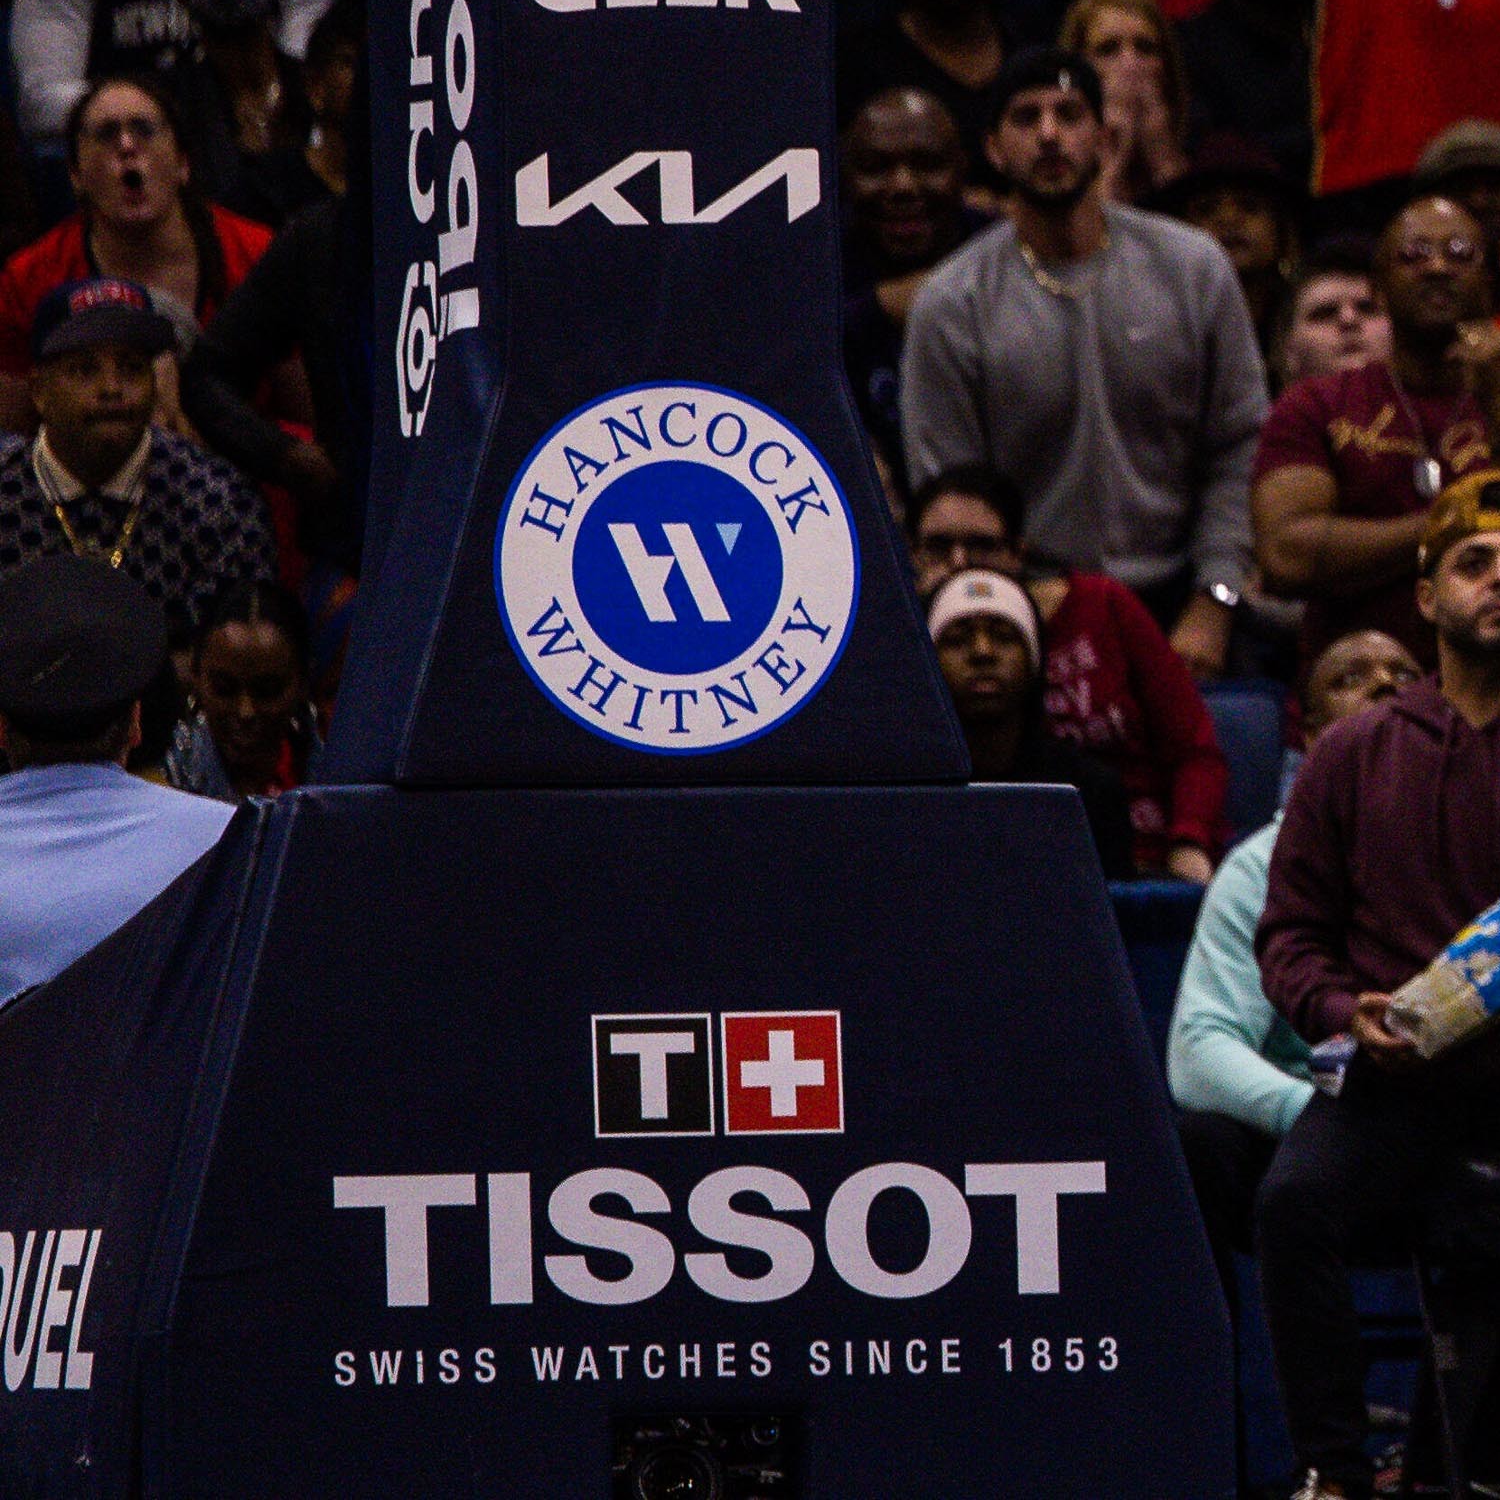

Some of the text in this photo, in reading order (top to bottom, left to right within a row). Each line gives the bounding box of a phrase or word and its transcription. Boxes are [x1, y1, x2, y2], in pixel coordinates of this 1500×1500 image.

[515, 148, 821, 227] KIA
[520, 402, 830, 543] HANCOCK
[526, 596, 832, 734] WHITNEY
[610, 1032, 696, 1120] T
[333, 1161, 1106, 1307] TISSOT
[334, 1336, 1120, 1387] SWISS WATCHES SINCE 1853
